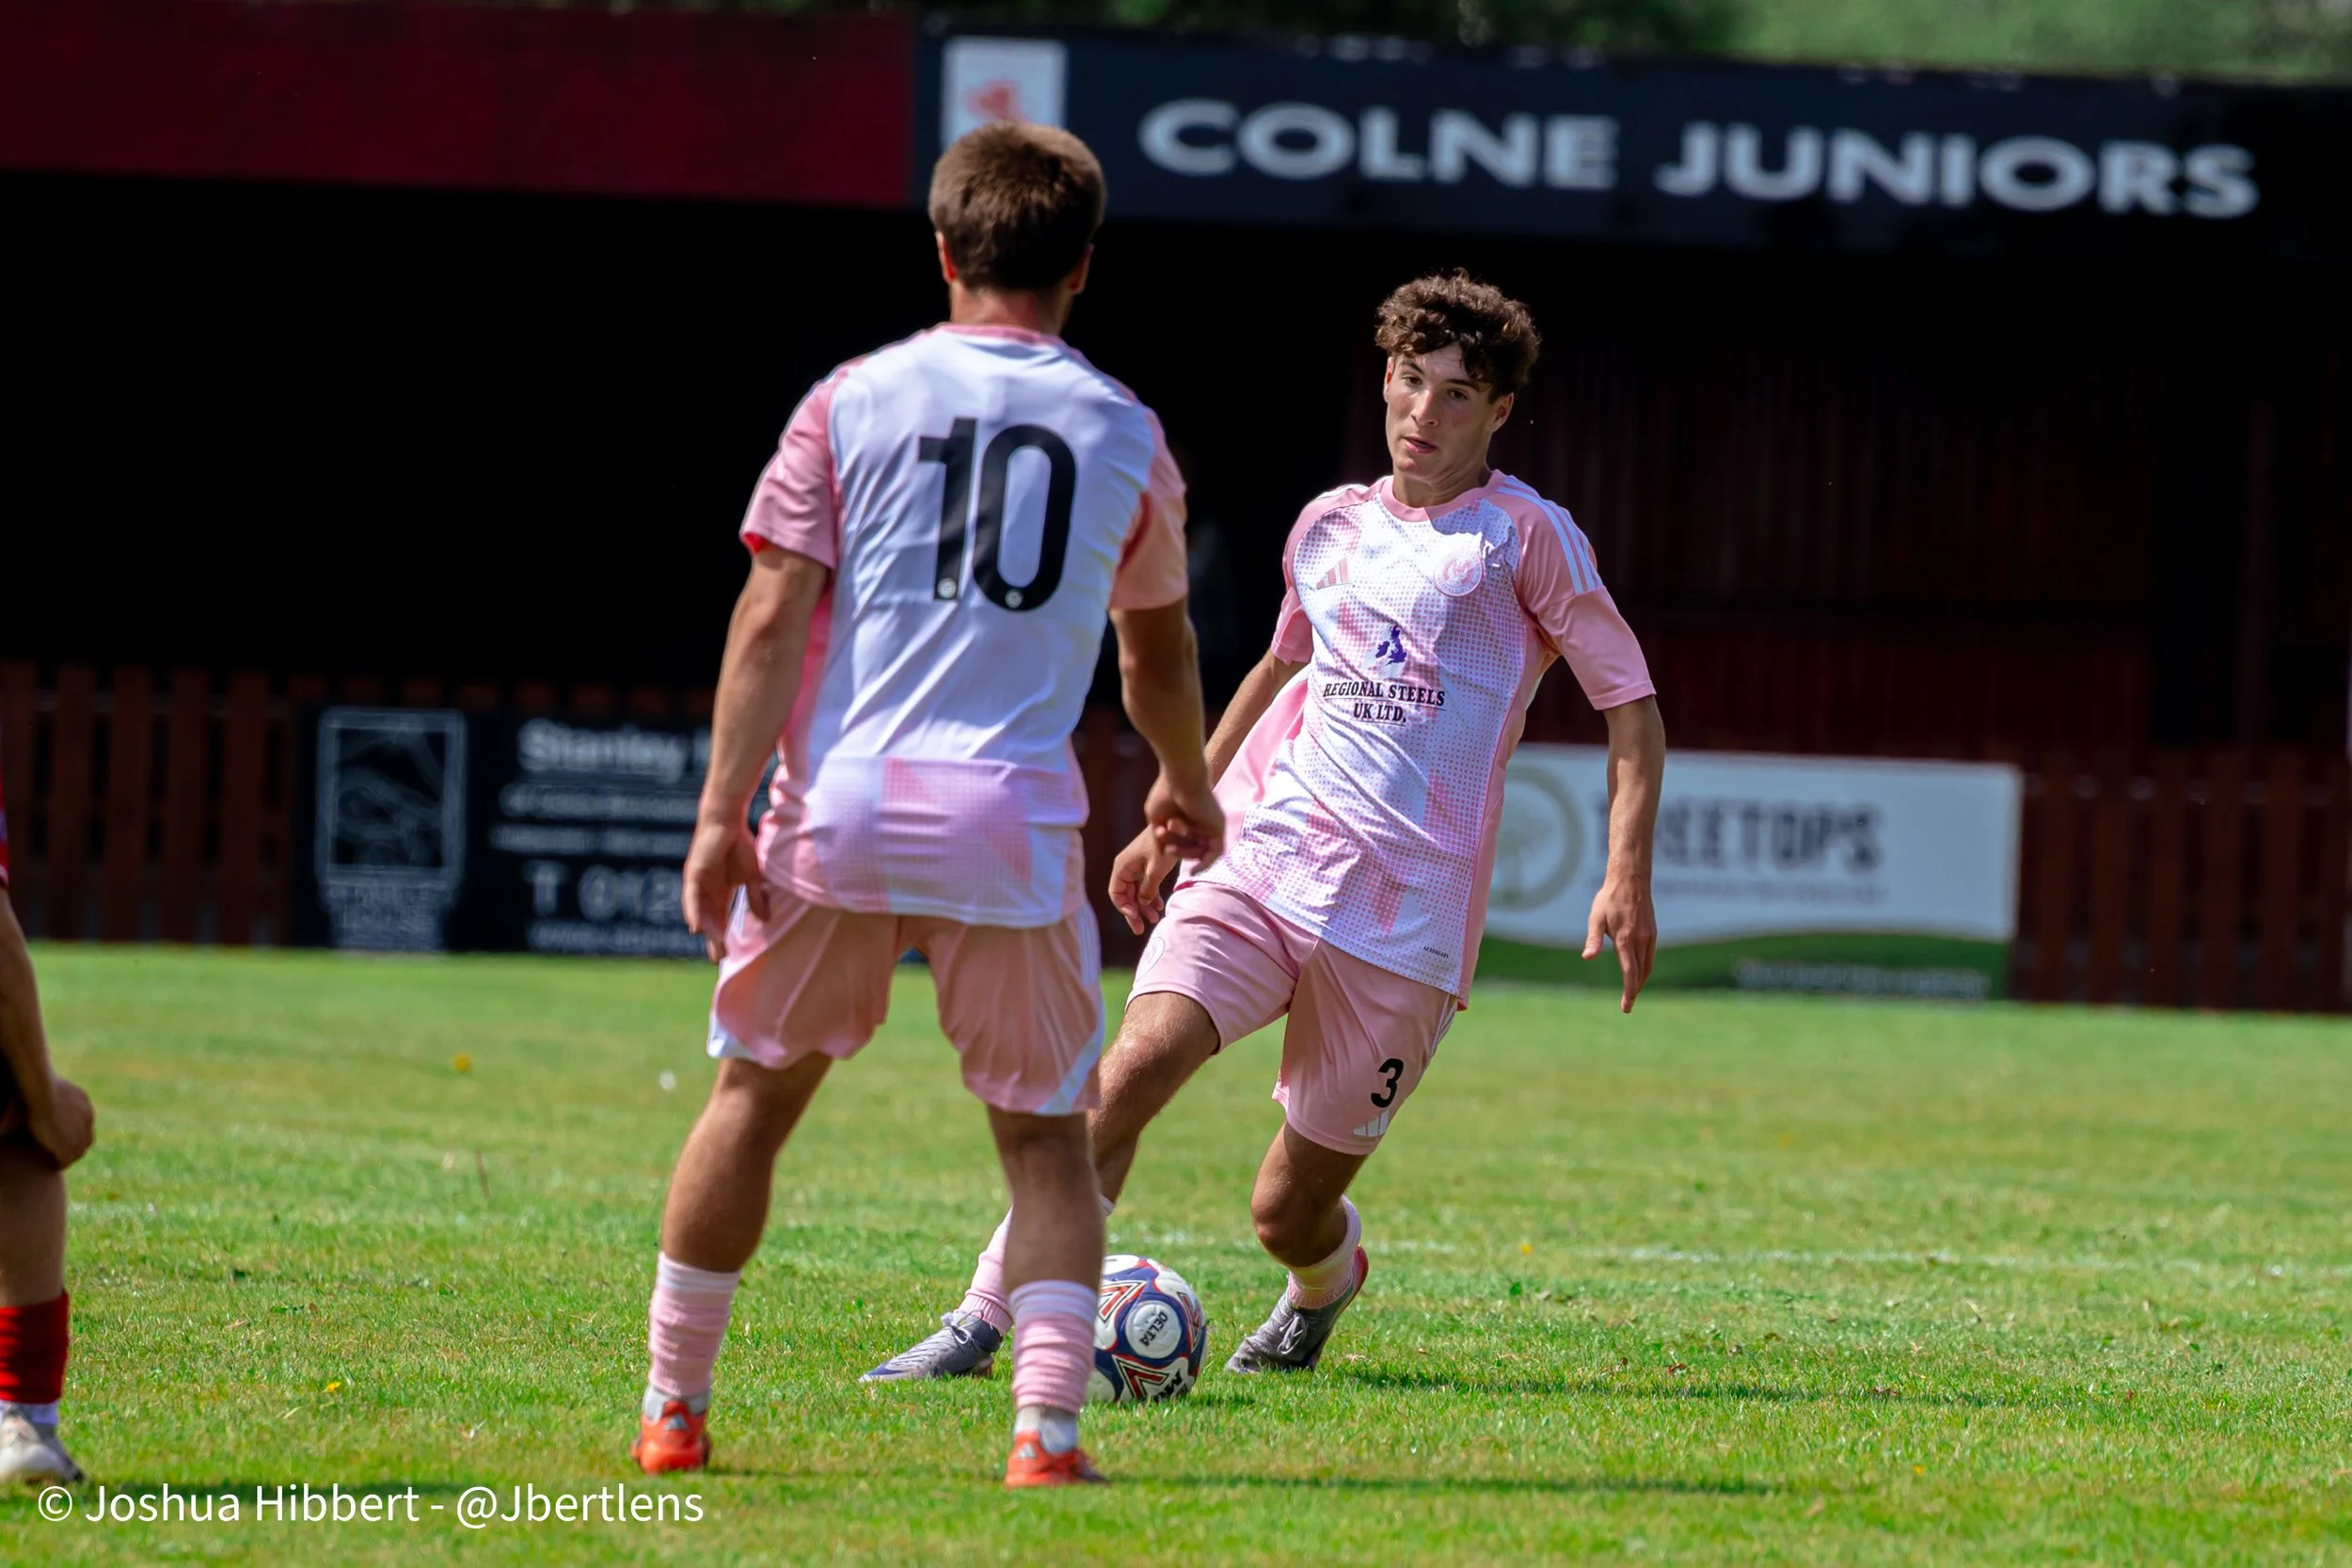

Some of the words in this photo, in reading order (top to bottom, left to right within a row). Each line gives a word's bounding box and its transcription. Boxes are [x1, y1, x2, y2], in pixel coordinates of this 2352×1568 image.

[1139, 100, 1616, 190] COLNE
[1656, 122, 2258, 218] JUNIORS
[916, 417, 1076, 613] 10
[1323, 681, 1384, 697] REGIONAL
[1388, 685, 1445, 706] STEELS
[1353, 703, 1375, 718] UK
[1375, 705, 1406, 723] LTD.
[1370, 1057, 1405, 1109] 3
[1139, 1311, 1168, 1347] DELTA
